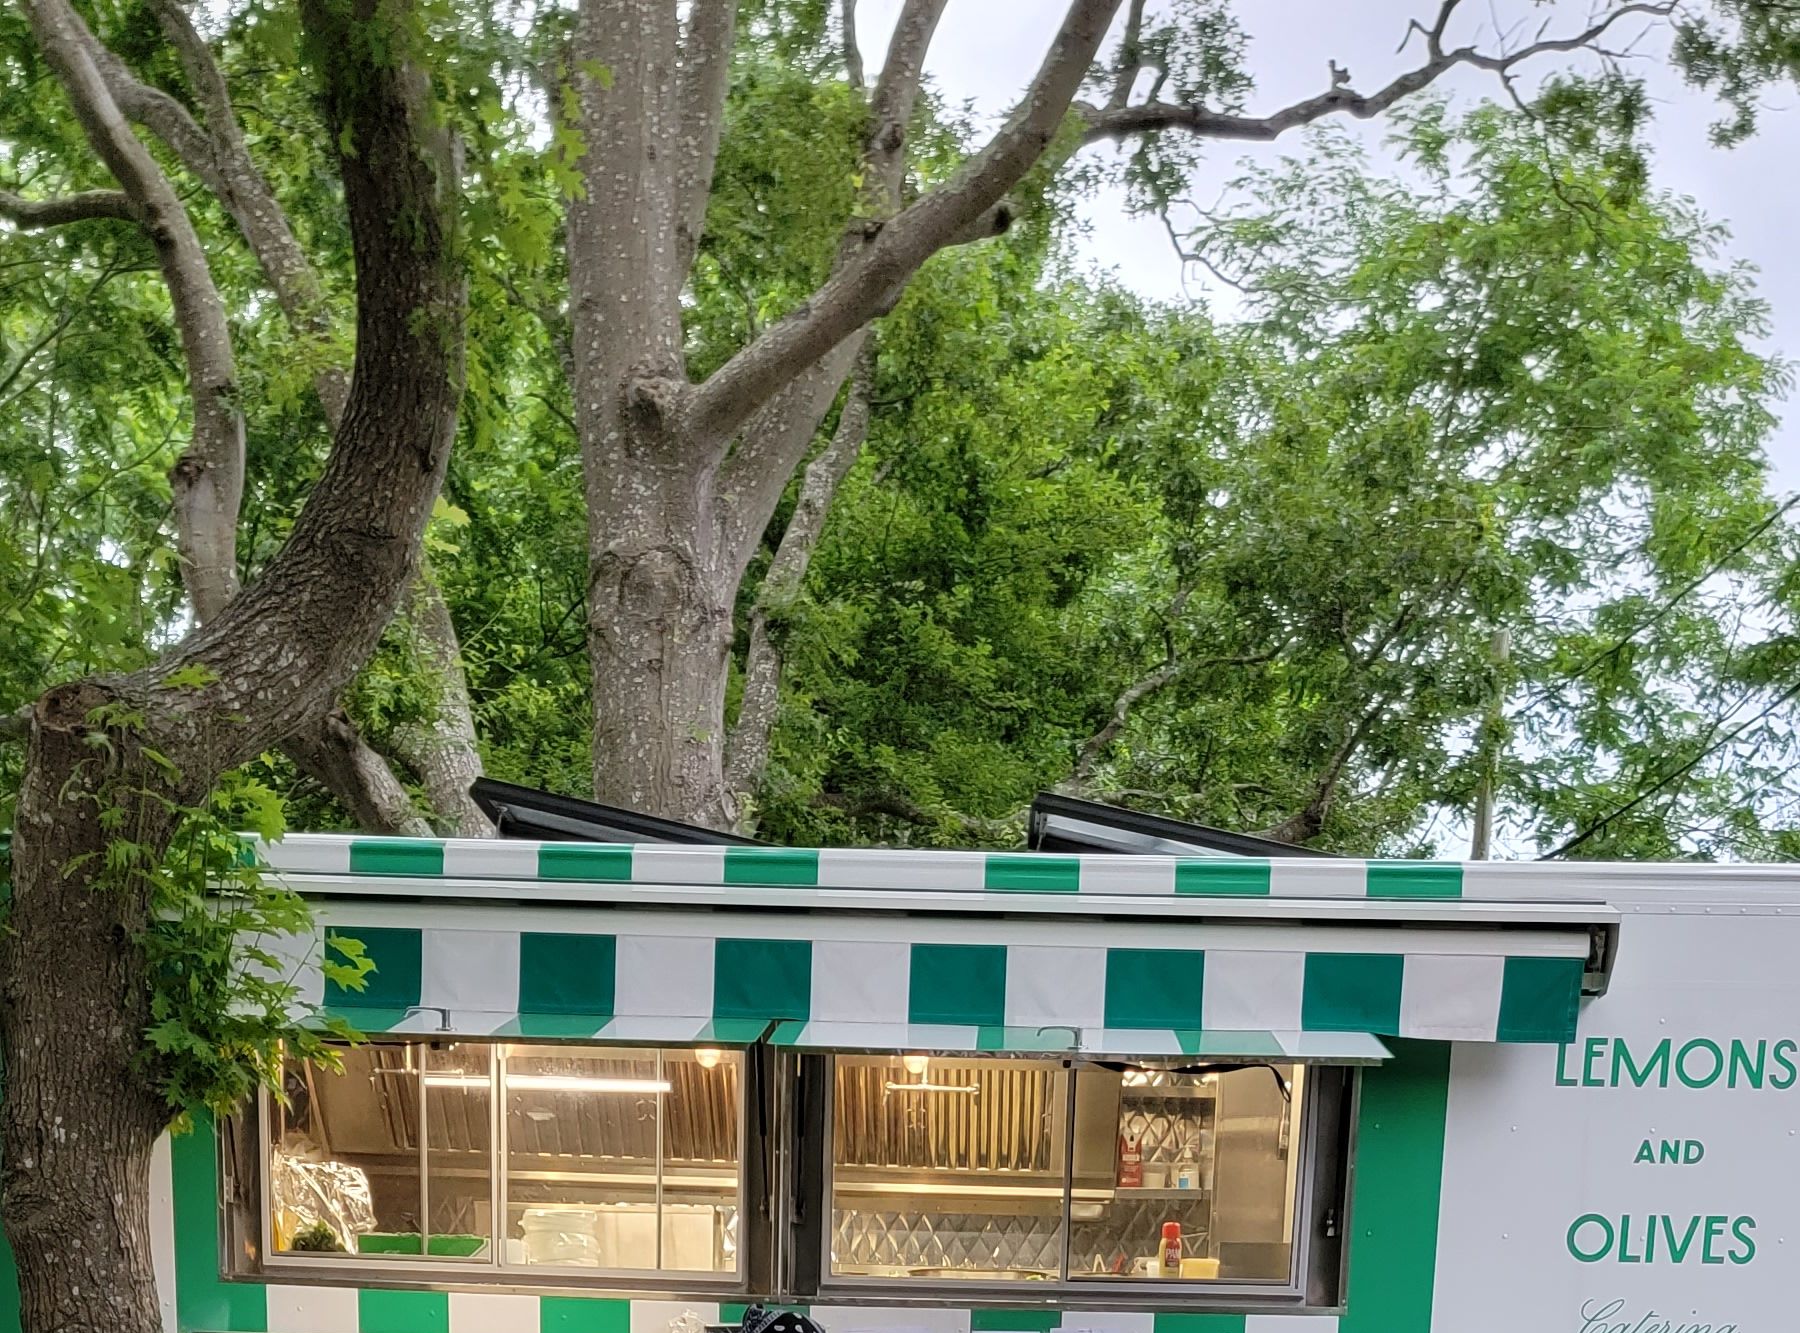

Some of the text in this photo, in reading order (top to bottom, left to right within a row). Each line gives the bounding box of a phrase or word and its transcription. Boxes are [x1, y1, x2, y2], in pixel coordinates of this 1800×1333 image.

[1555, 1037, 1798, 1090] LEMONS
[1633, 1139, 1705, 1165] AND
[1566, 1213, 1757, 1265] OLIVES
